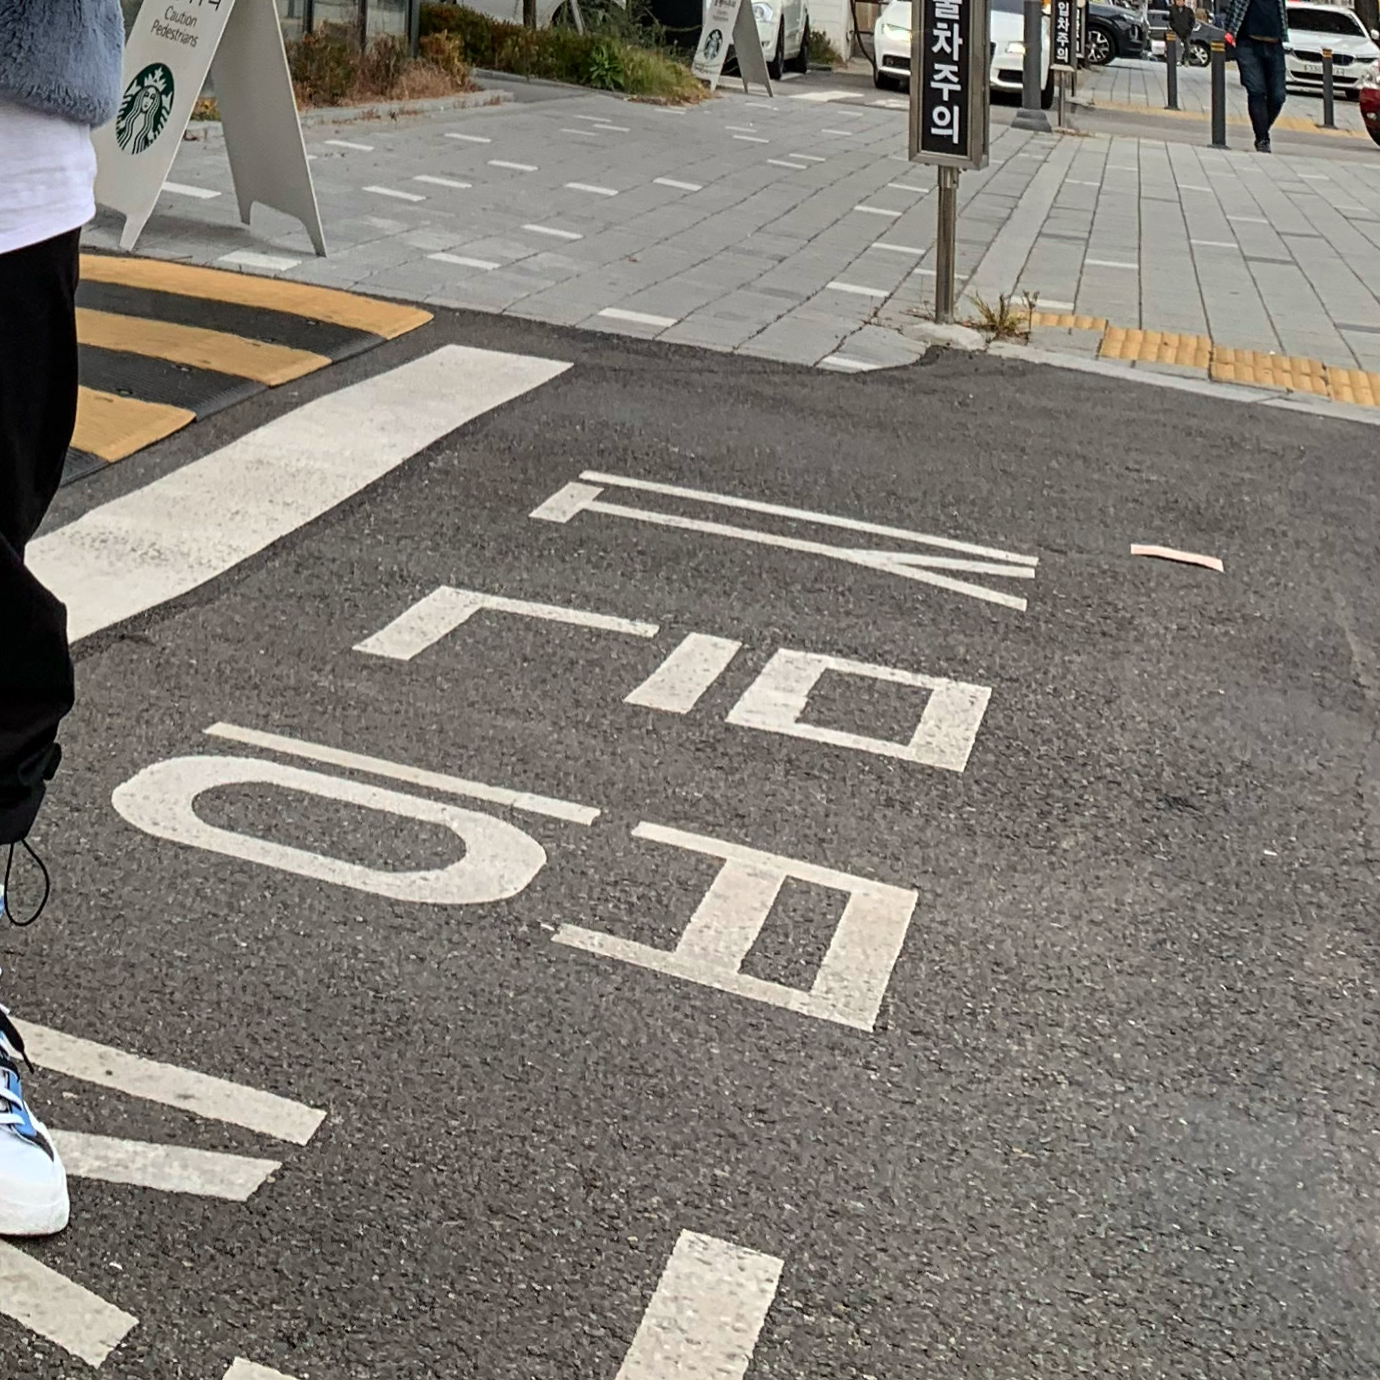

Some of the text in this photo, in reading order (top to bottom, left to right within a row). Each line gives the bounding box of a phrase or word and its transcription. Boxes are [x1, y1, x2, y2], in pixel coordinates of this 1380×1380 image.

[164, 5, 198, 28] Caution
[151, 19, 199, 48] Pedestrians
[1056, 1, 1070, 63] 입차주의
